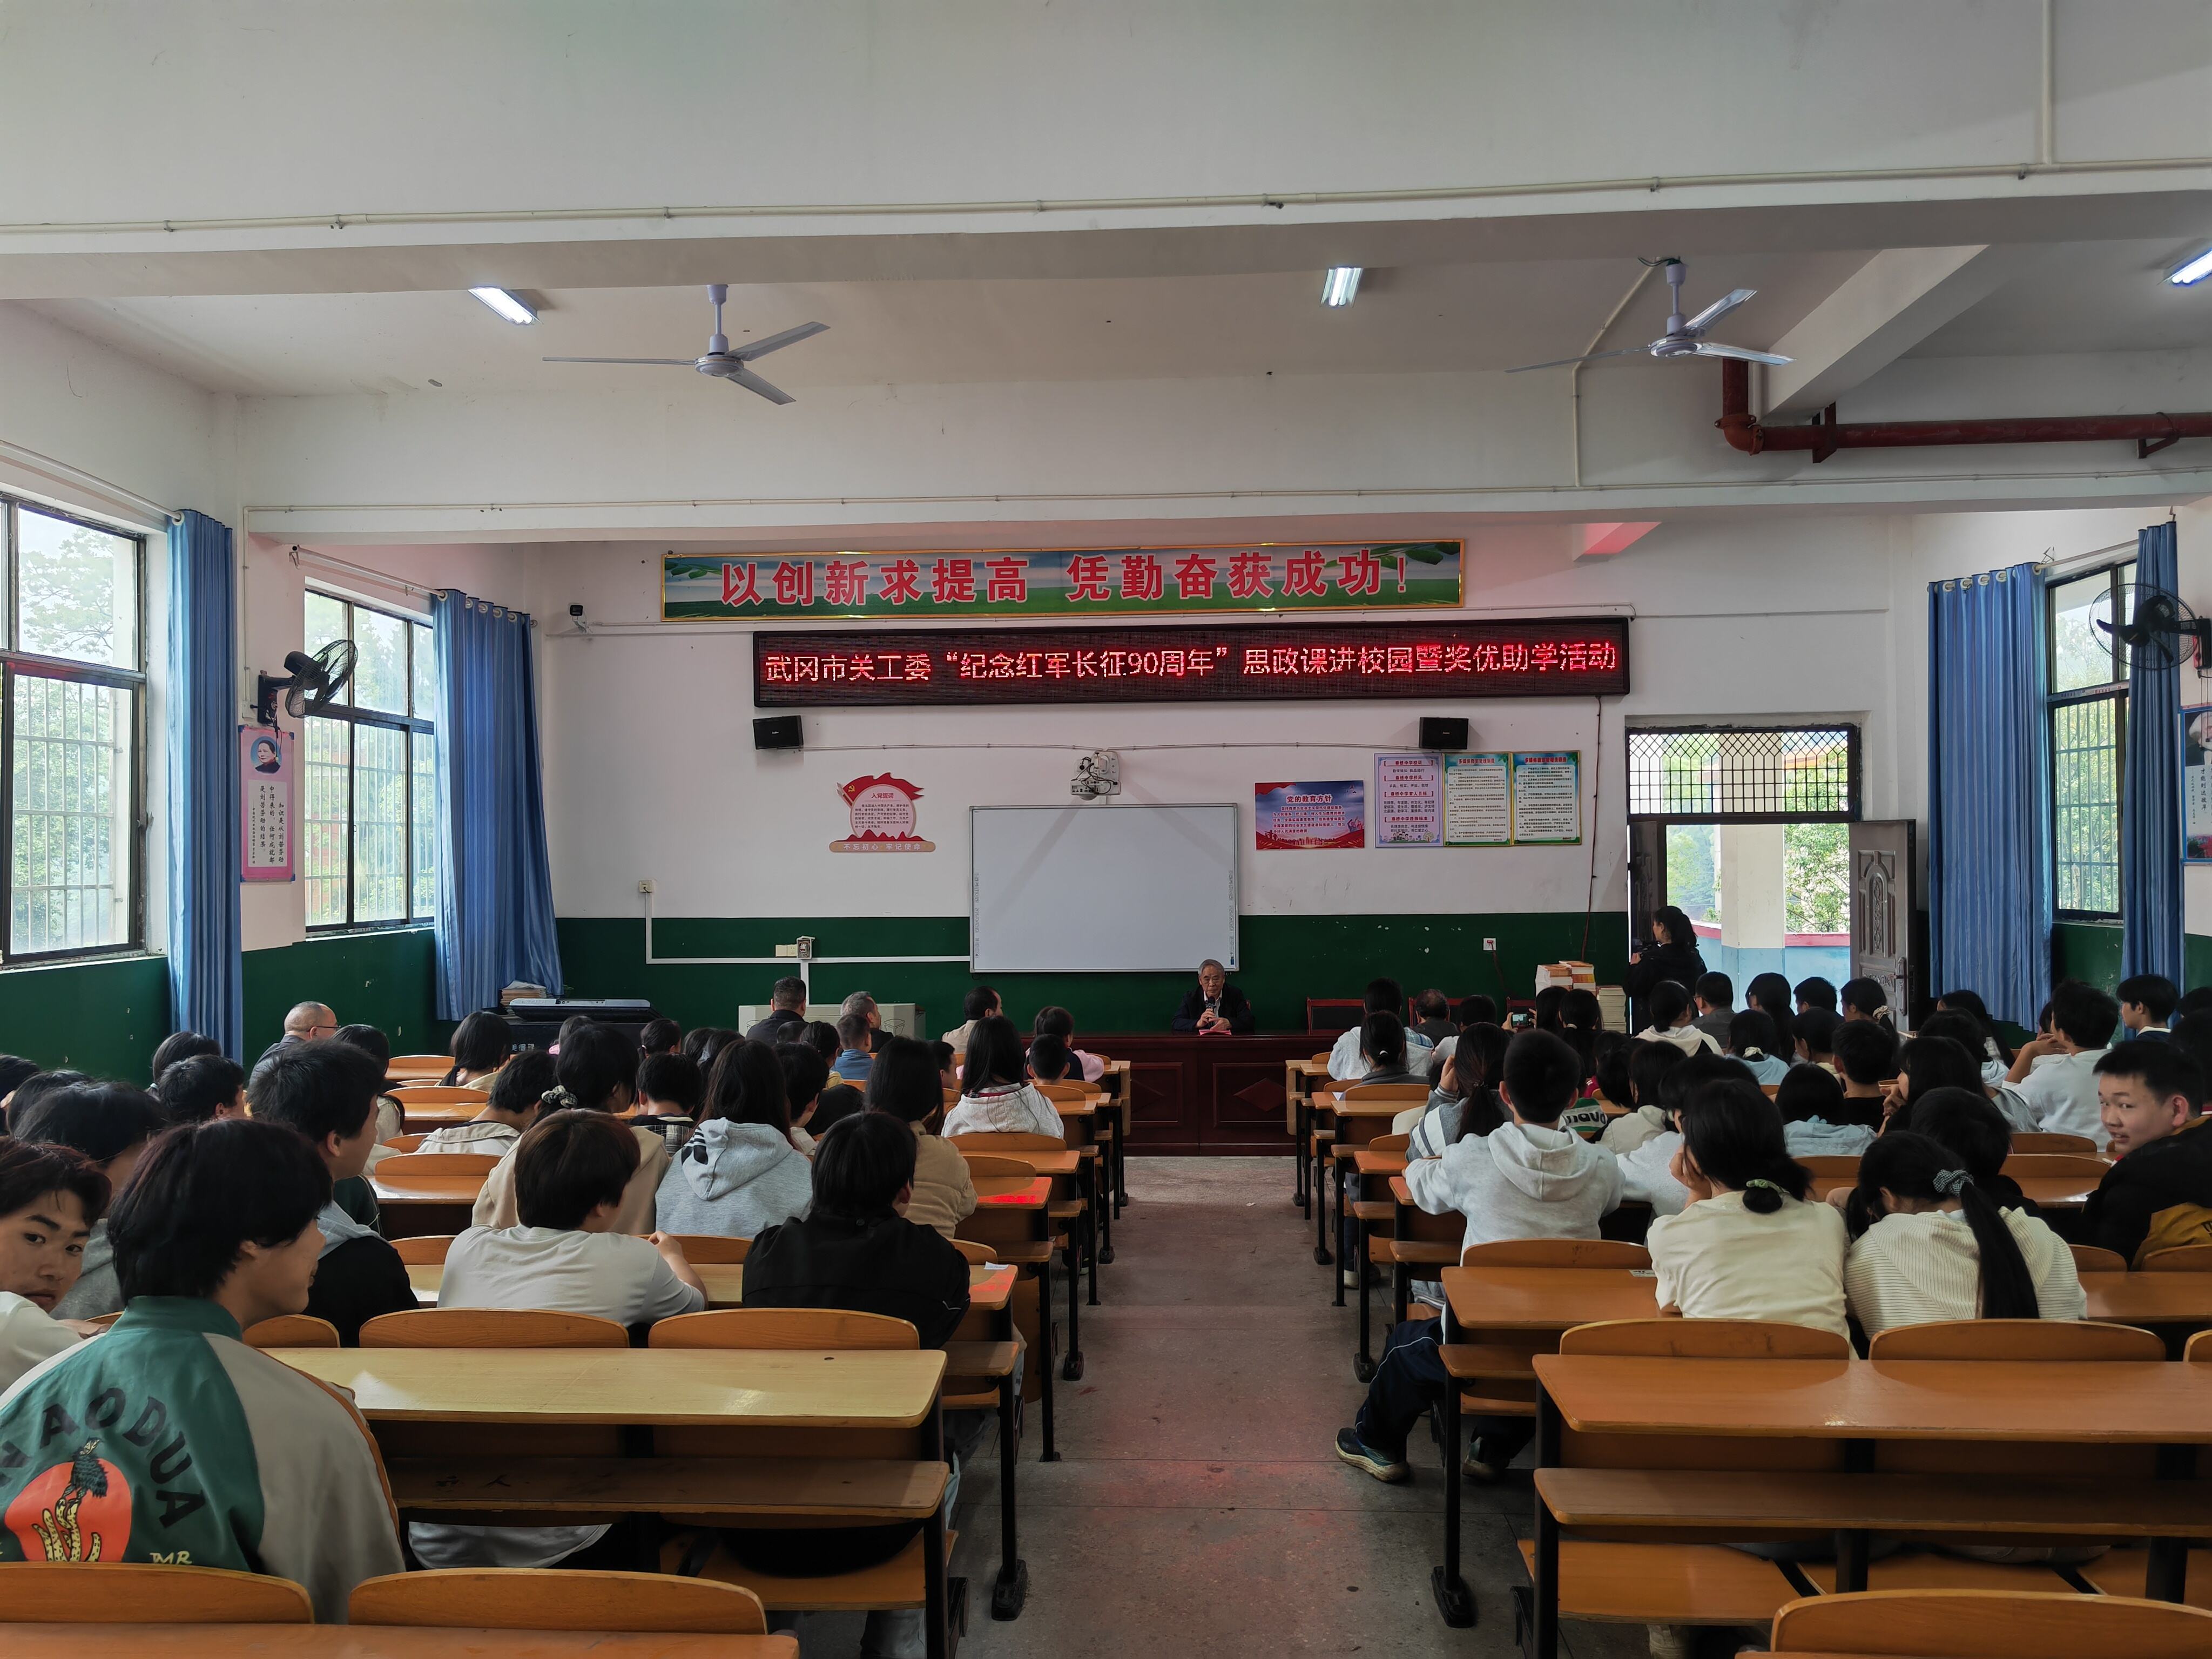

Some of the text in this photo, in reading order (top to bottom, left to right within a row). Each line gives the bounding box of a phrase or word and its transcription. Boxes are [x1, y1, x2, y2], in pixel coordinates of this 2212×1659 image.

[721, 550, 1406, 606] 以创新求提高 凭勤奋获成功！
[1286, 795, 1332, 803] 党的教育方针
